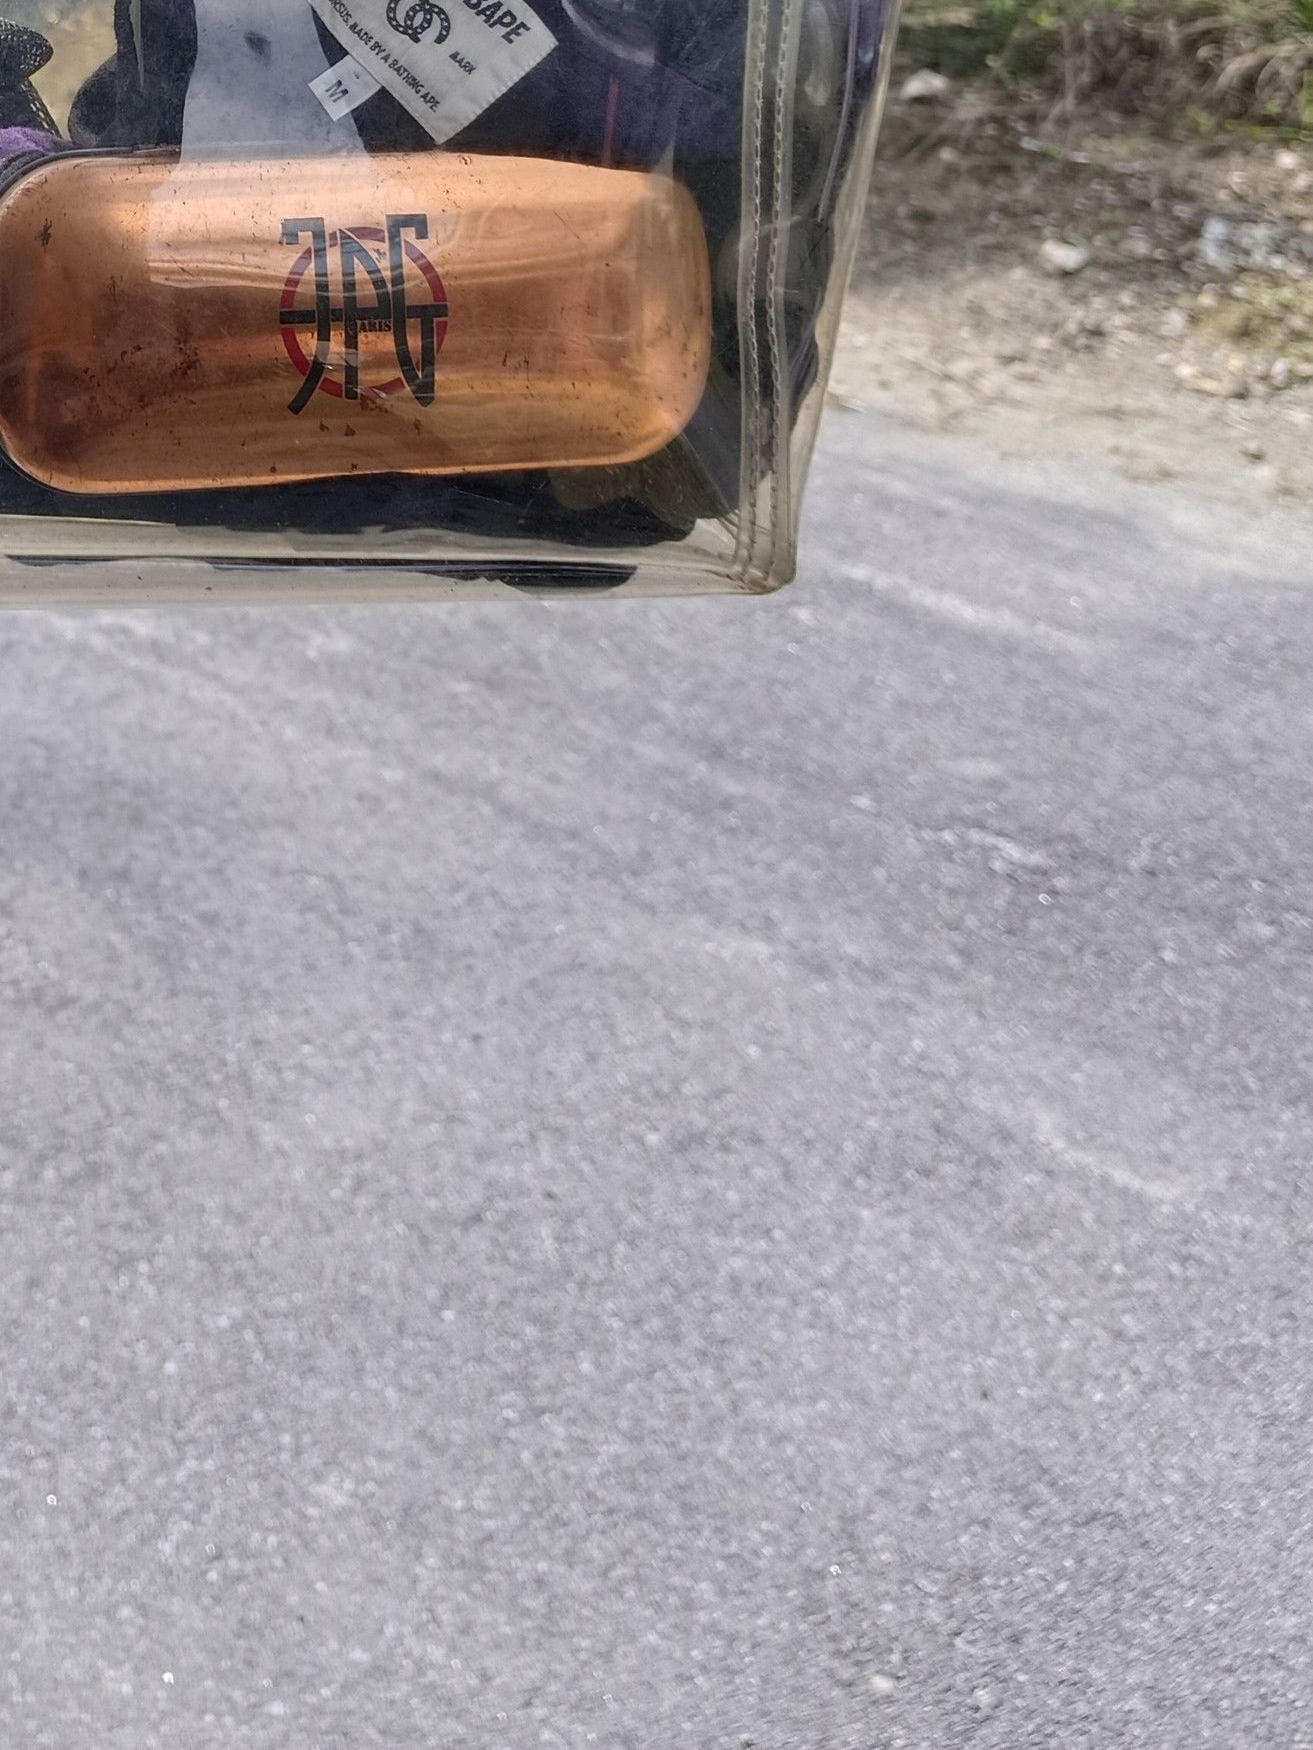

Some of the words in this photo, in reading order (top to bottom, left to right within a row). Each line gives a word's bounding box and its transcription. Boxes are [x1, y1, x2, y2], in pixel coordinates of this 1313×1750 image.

[349, 21, 374, 45] MADE
[370, 41, 386, 55] BY
[381, 53, 391, 63] A
[389, 59, 424, 94] BATHING
[448, 51, 477, 76] MARK
[325, 79, 349, 103] M
